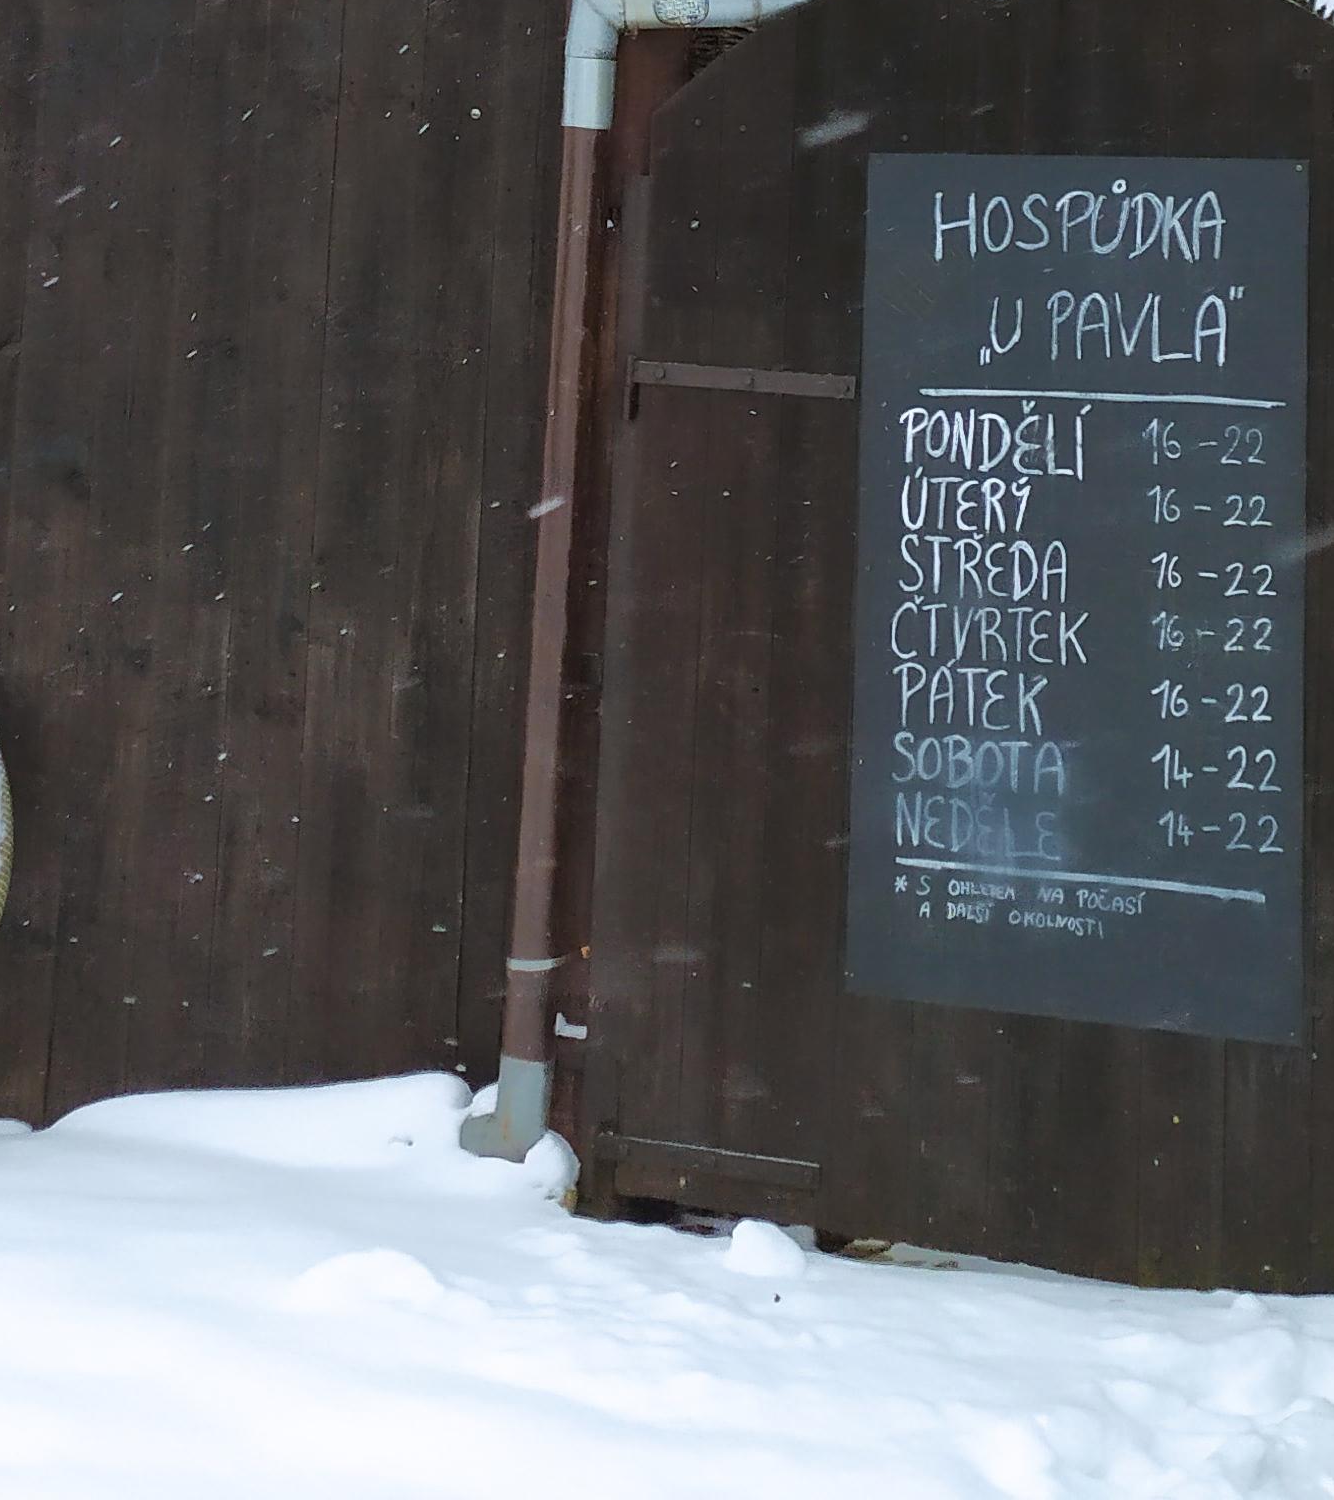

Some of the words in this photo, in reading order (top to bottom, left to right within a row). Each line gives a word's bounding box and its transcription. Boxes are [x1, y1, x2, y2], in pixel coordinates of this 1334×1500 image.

[933, 178, 1227, 264] HOSPŮDKA
[899, 400, 1092, 481] PONDĚLÍ
[901, 466, 1032, 533] ÚTERÝ
[898, 533, 1067, 603] STŘEDA
[891, 595, 1089, 665] ČTVRTEK
[893, 658, 1048, 735] PÁTEK
[892, 731, 1065, 796] SOBOTA
[896, 791, 1061, 861] NEDĚLE
[919, 901, 931, 918] A
[1008, 909, 1104, 939] OKOLNOSTI
[1038, 886, 1064, 904] NA
[1076, 888, 1146, 915] POČASÍ
